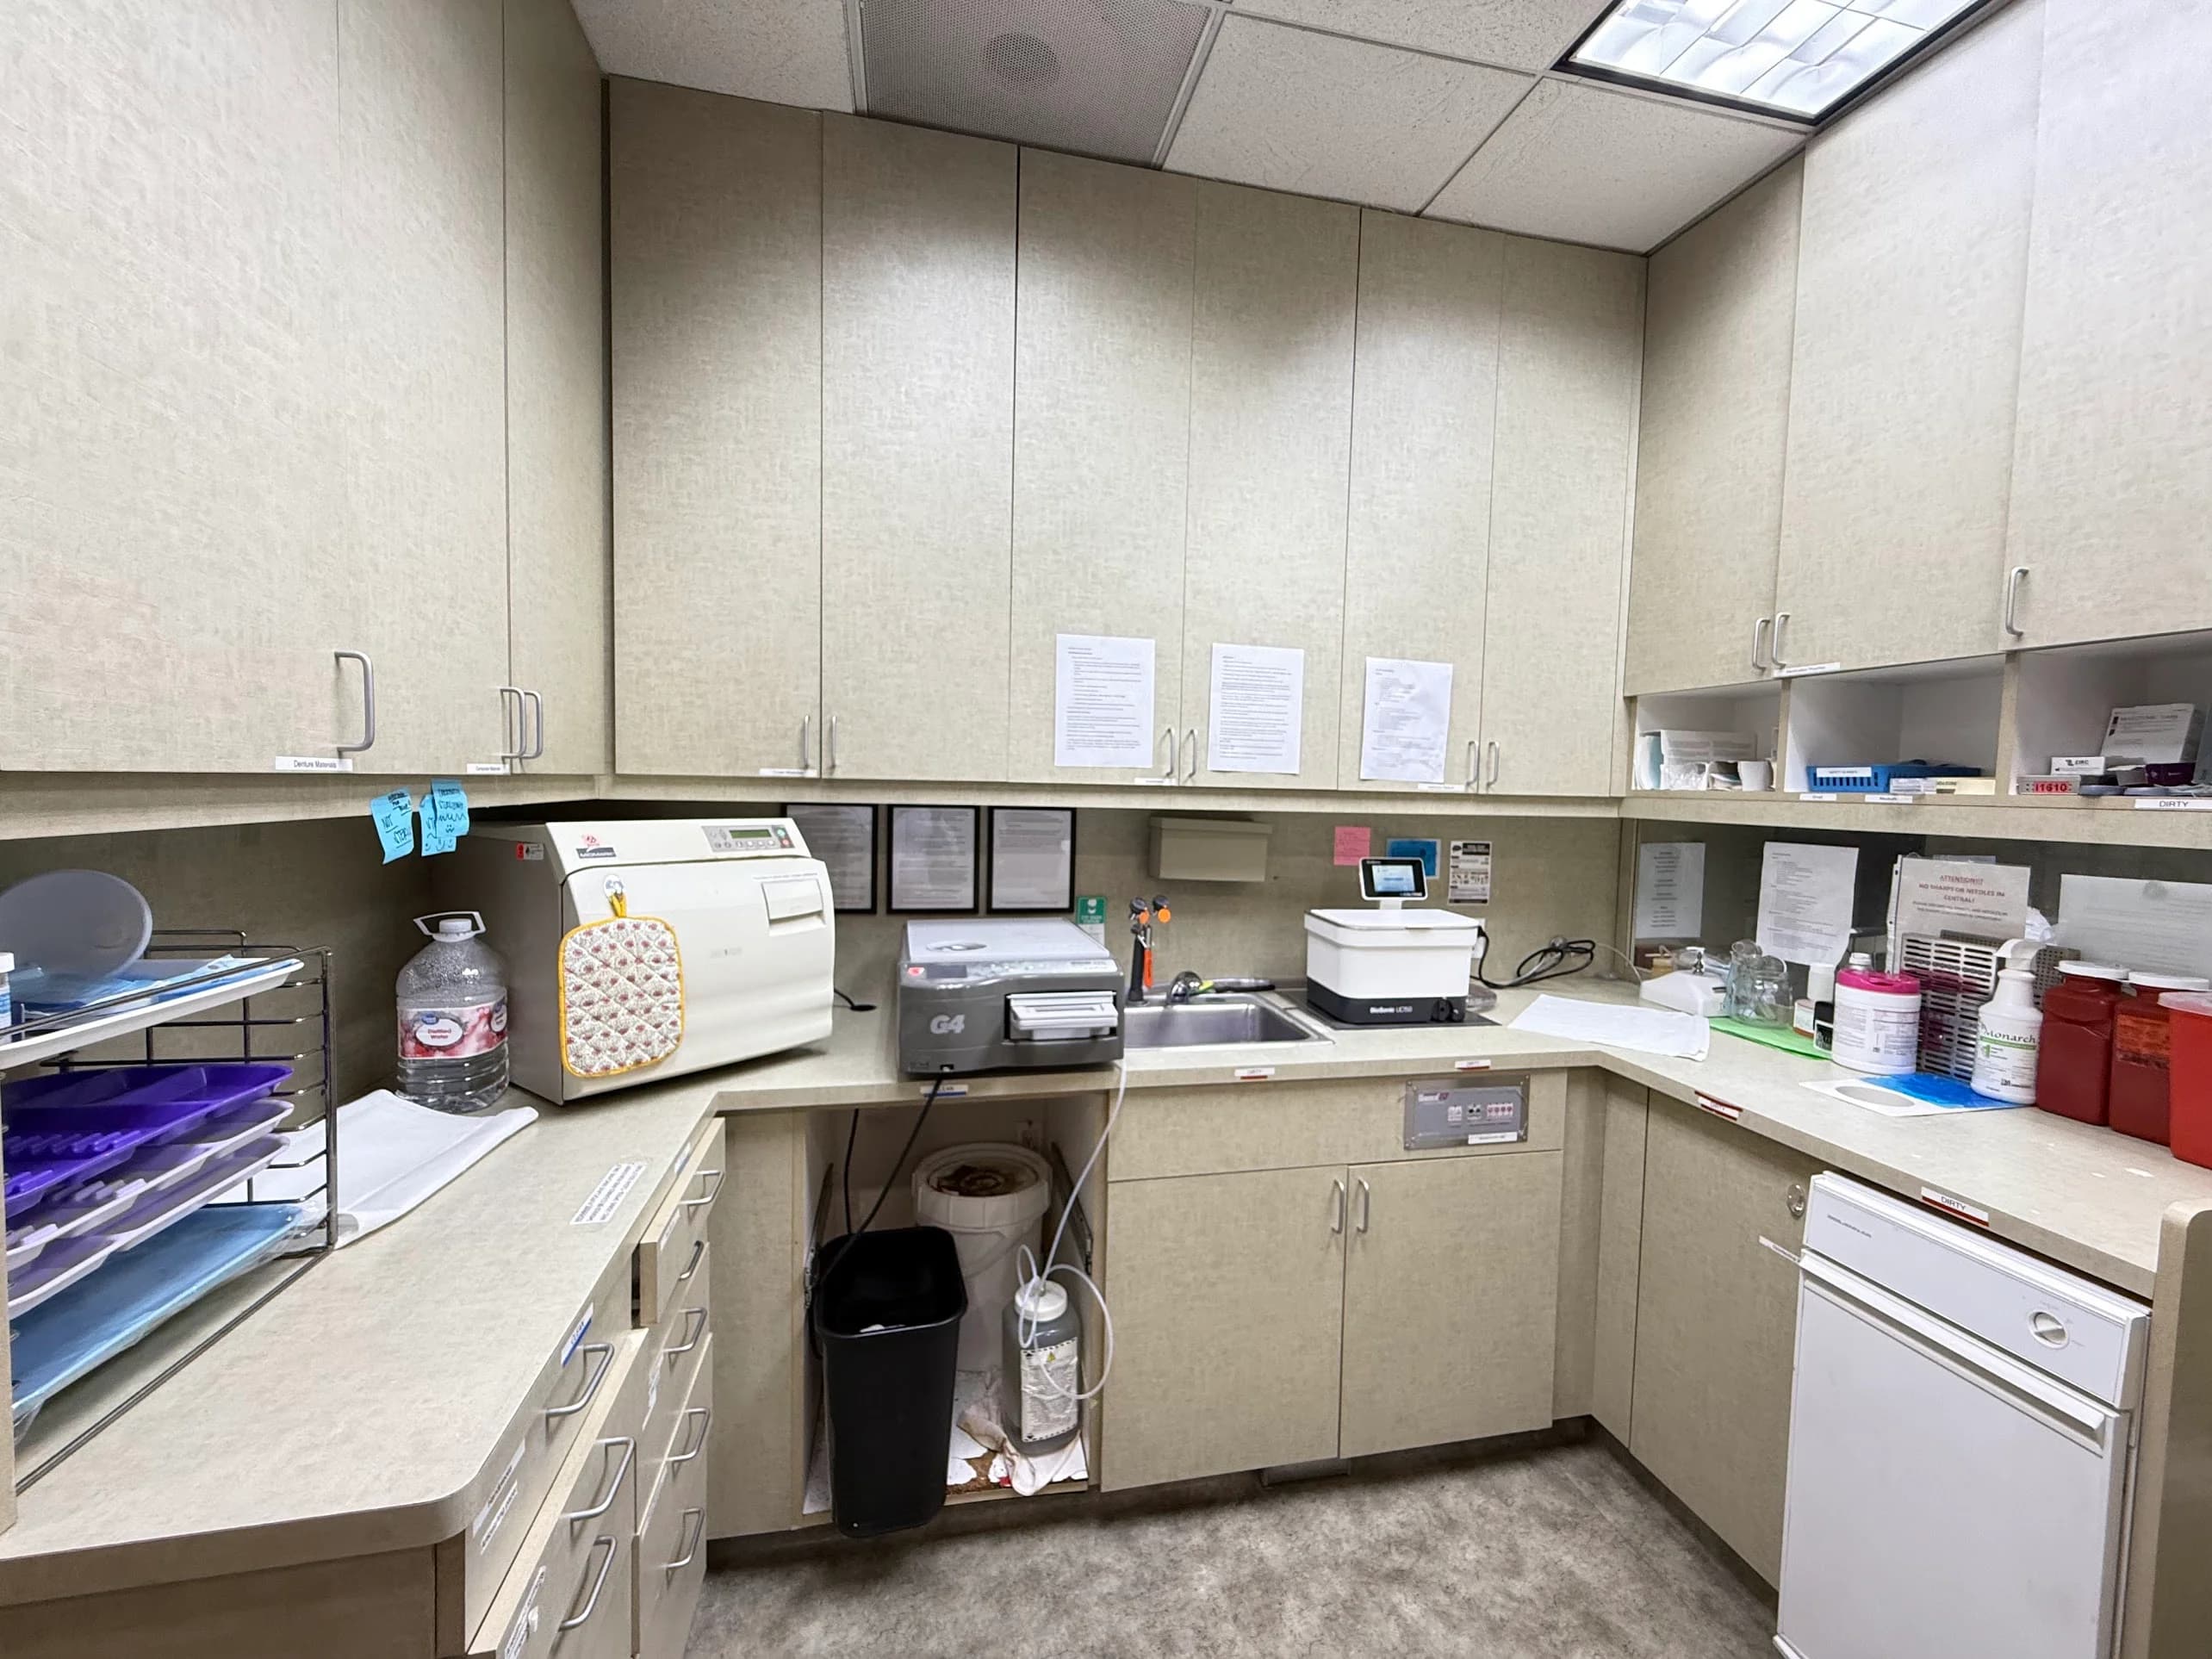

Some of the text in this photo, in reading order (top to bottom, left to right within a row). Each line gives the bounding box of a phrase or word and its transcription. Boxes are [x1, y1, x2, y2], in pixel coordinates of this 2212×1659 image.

[1930, 885, 1954, 893] SHARPS
[1967, 888, 1995, 897] NEEDLES
[930, 1015, 965, 1034] G4
[1980, 1023, 2036, 1043] Monarch
[1941, 1196, 1966, 1211] DIRTY
